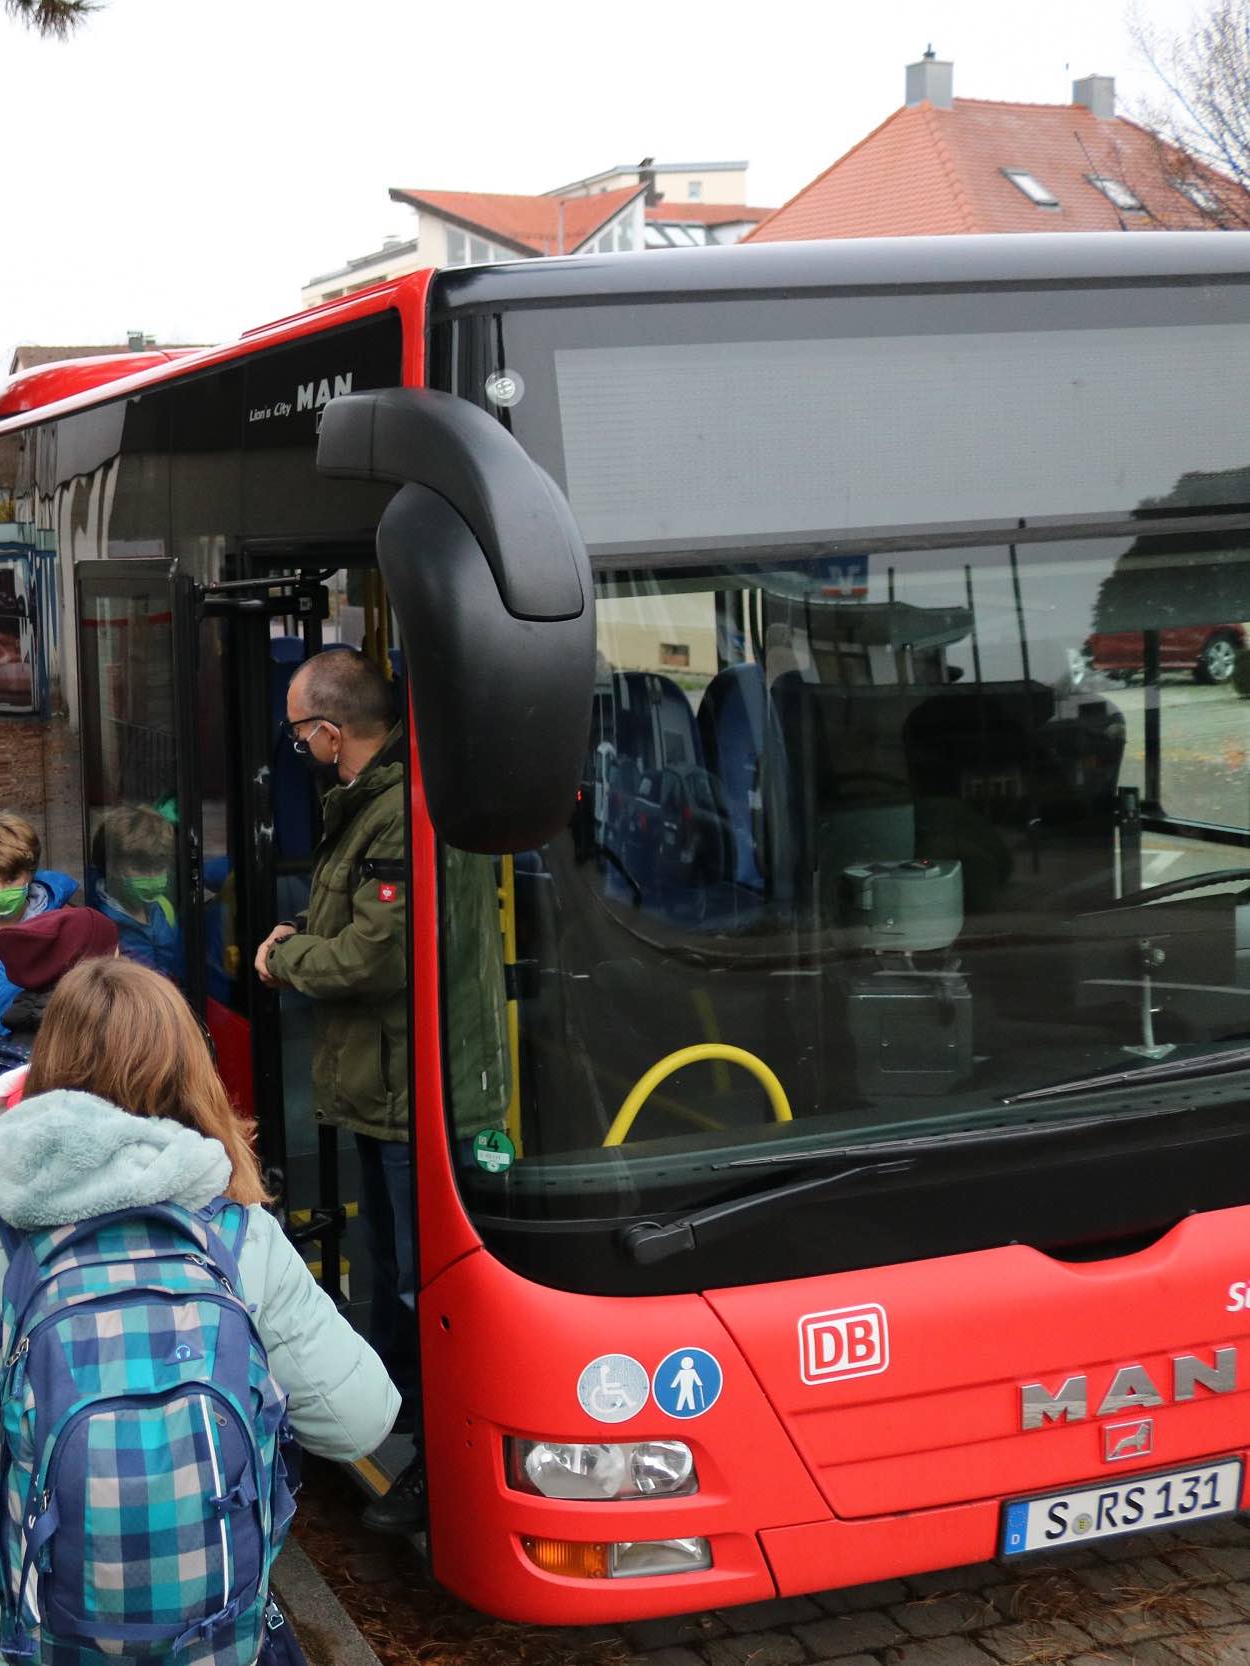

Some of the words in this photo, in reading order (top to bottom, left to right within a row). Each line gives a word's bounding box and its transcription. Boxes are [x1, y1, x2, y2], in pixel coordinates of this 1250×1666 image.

[274, 402, 292, 417] City
[297, 372, 353, 412] MAN
[487, 1131, 499, 1151] 4
[1226, 1281, 1250, 1312] S
[813, 1319, 876, 1370] DB
[1020, 1348, 1238, 1430] MAN
[1045, 1501, 1069, 1540] S
[1096, 1486, 1145, 1531] RS
[1153, 1471, 1221, 1519] 131
[1011, 1534, 1020, 1545] D
